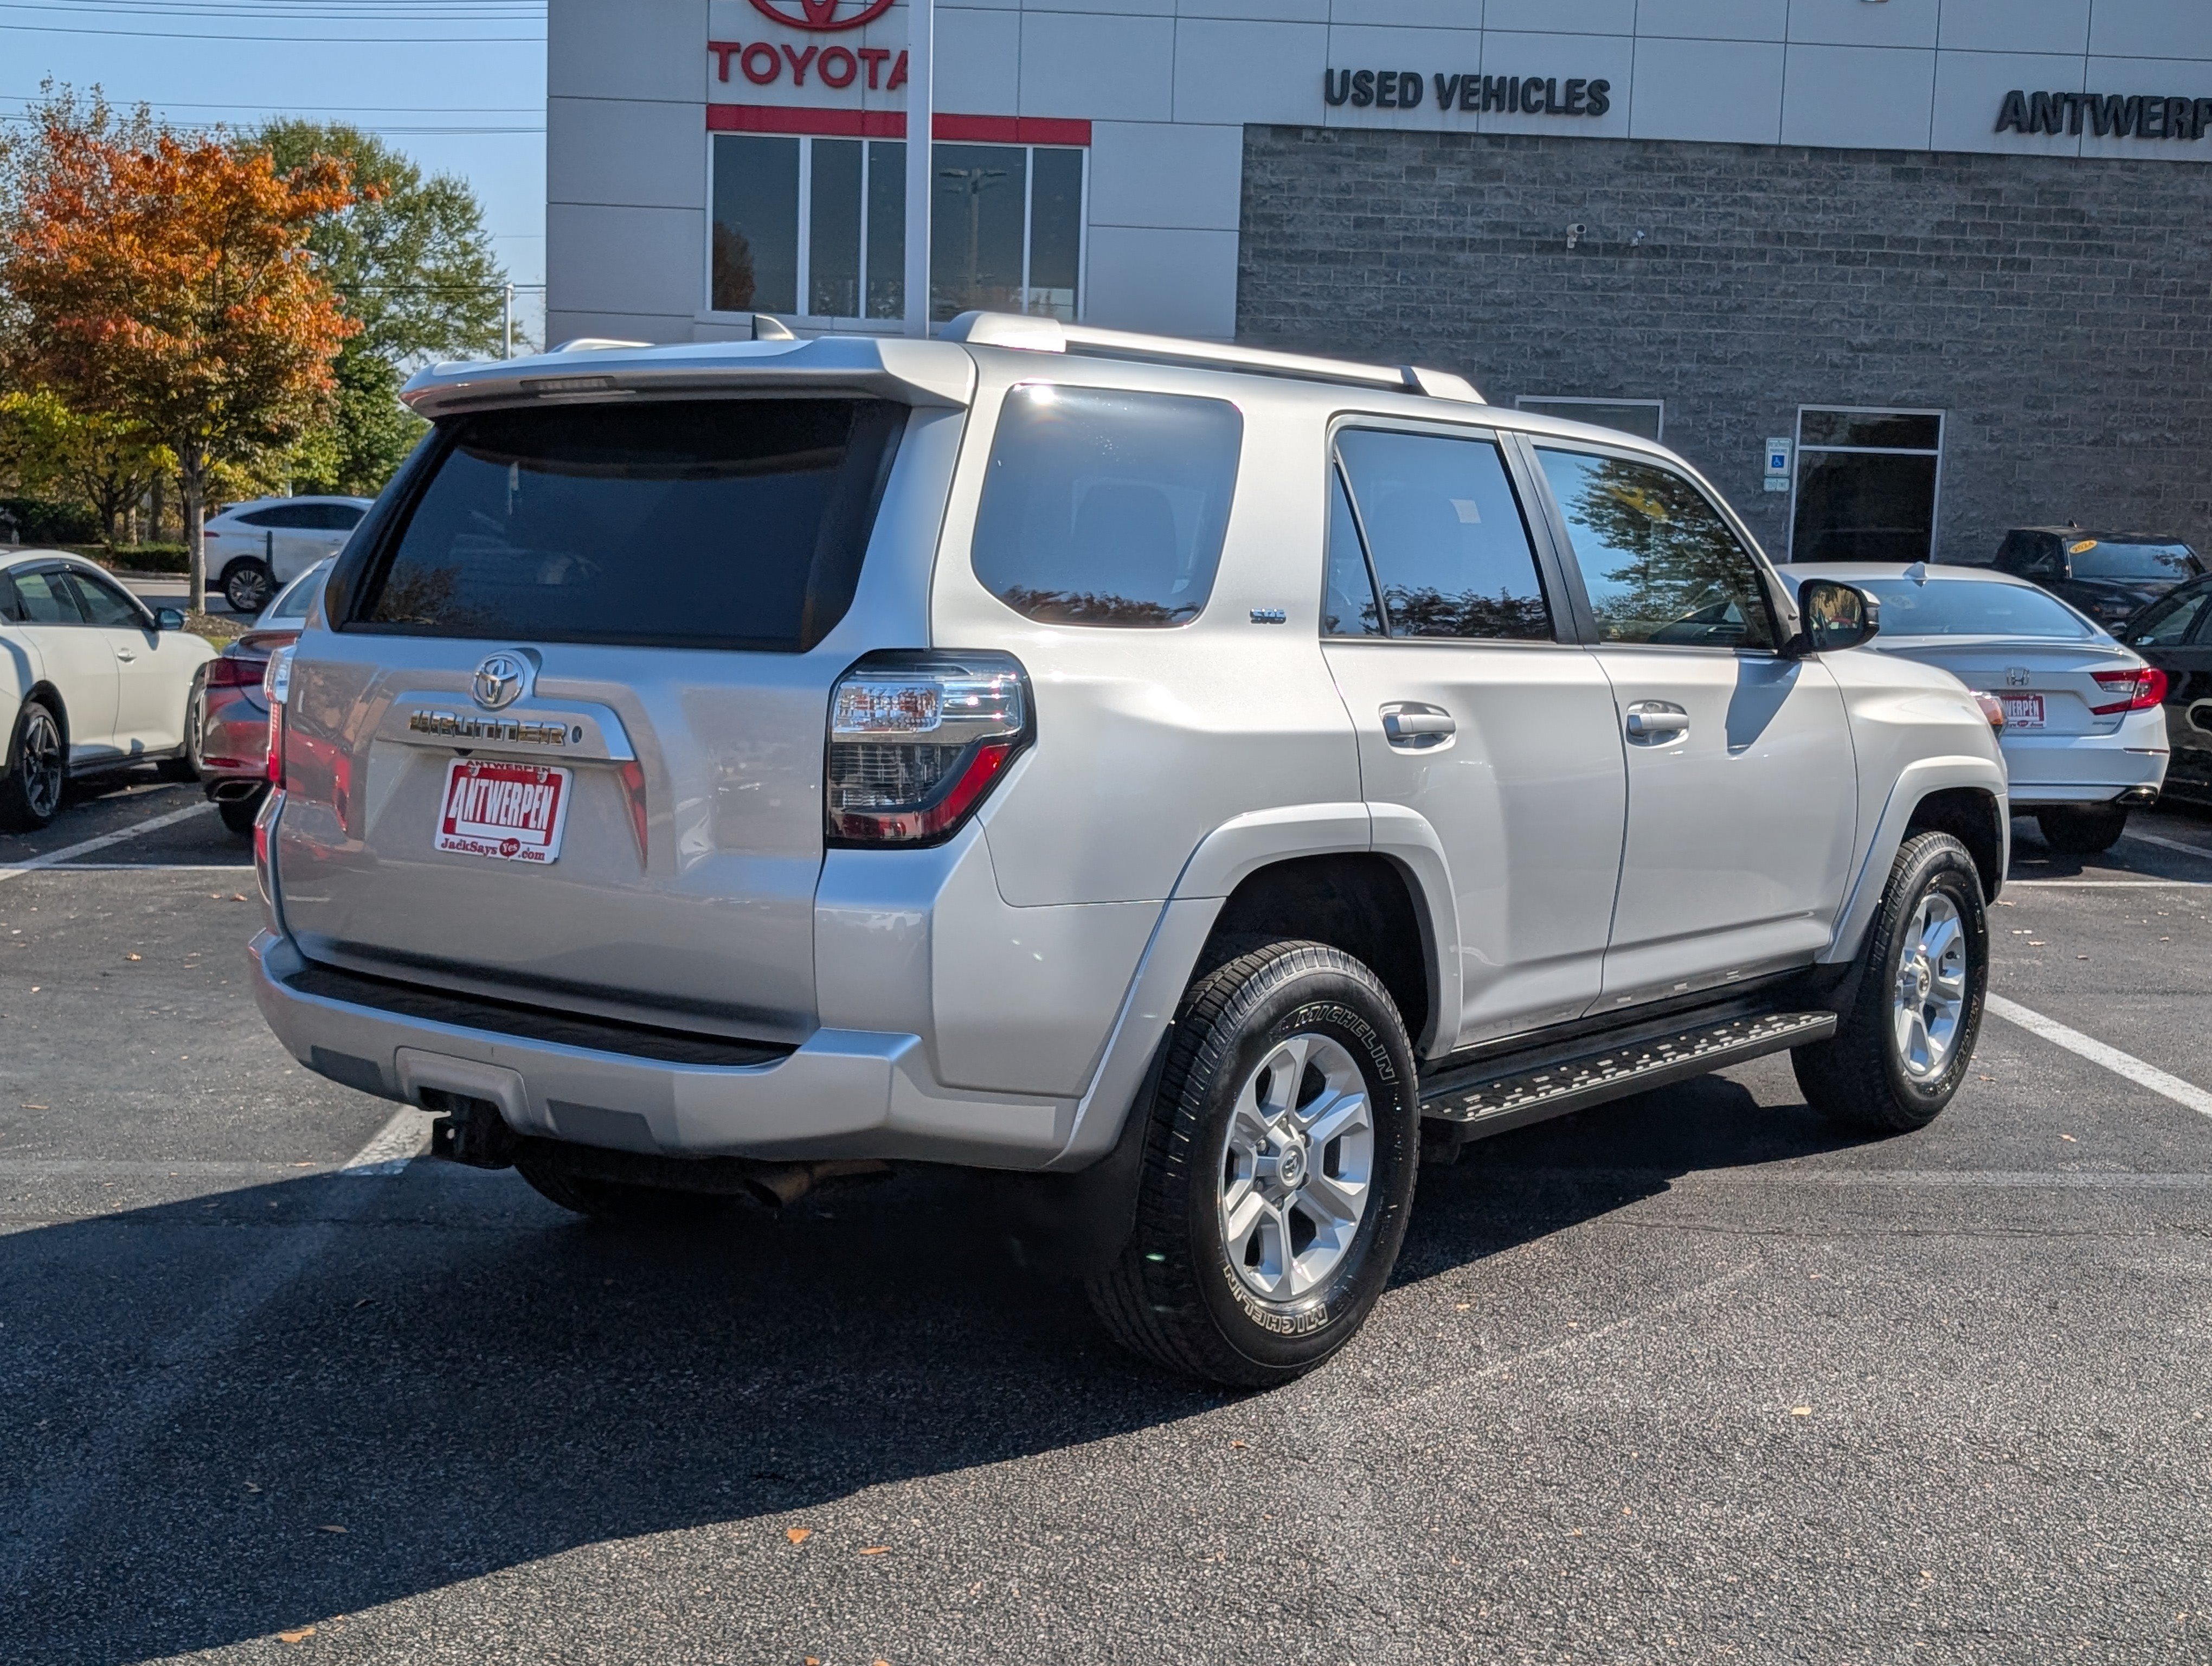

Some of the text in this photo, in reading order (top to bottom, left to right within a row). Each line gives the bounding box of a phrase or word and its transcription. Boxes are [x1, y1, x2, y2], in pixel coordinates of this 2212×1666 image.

[1324, 68, 1611, 117] USED VEHICLES
[1249, 608, 1287, 624] SR5
[410, 710, 567, 747] 4RUNNER
[466, 760, 551, 773] ANTWERPEN
[447, 777, 555, 830] ANTWERPEN
[1294, 1004, 1396, 1081] MICHELIN
[1223, 1264, 1329, 1335] MICHELIN
